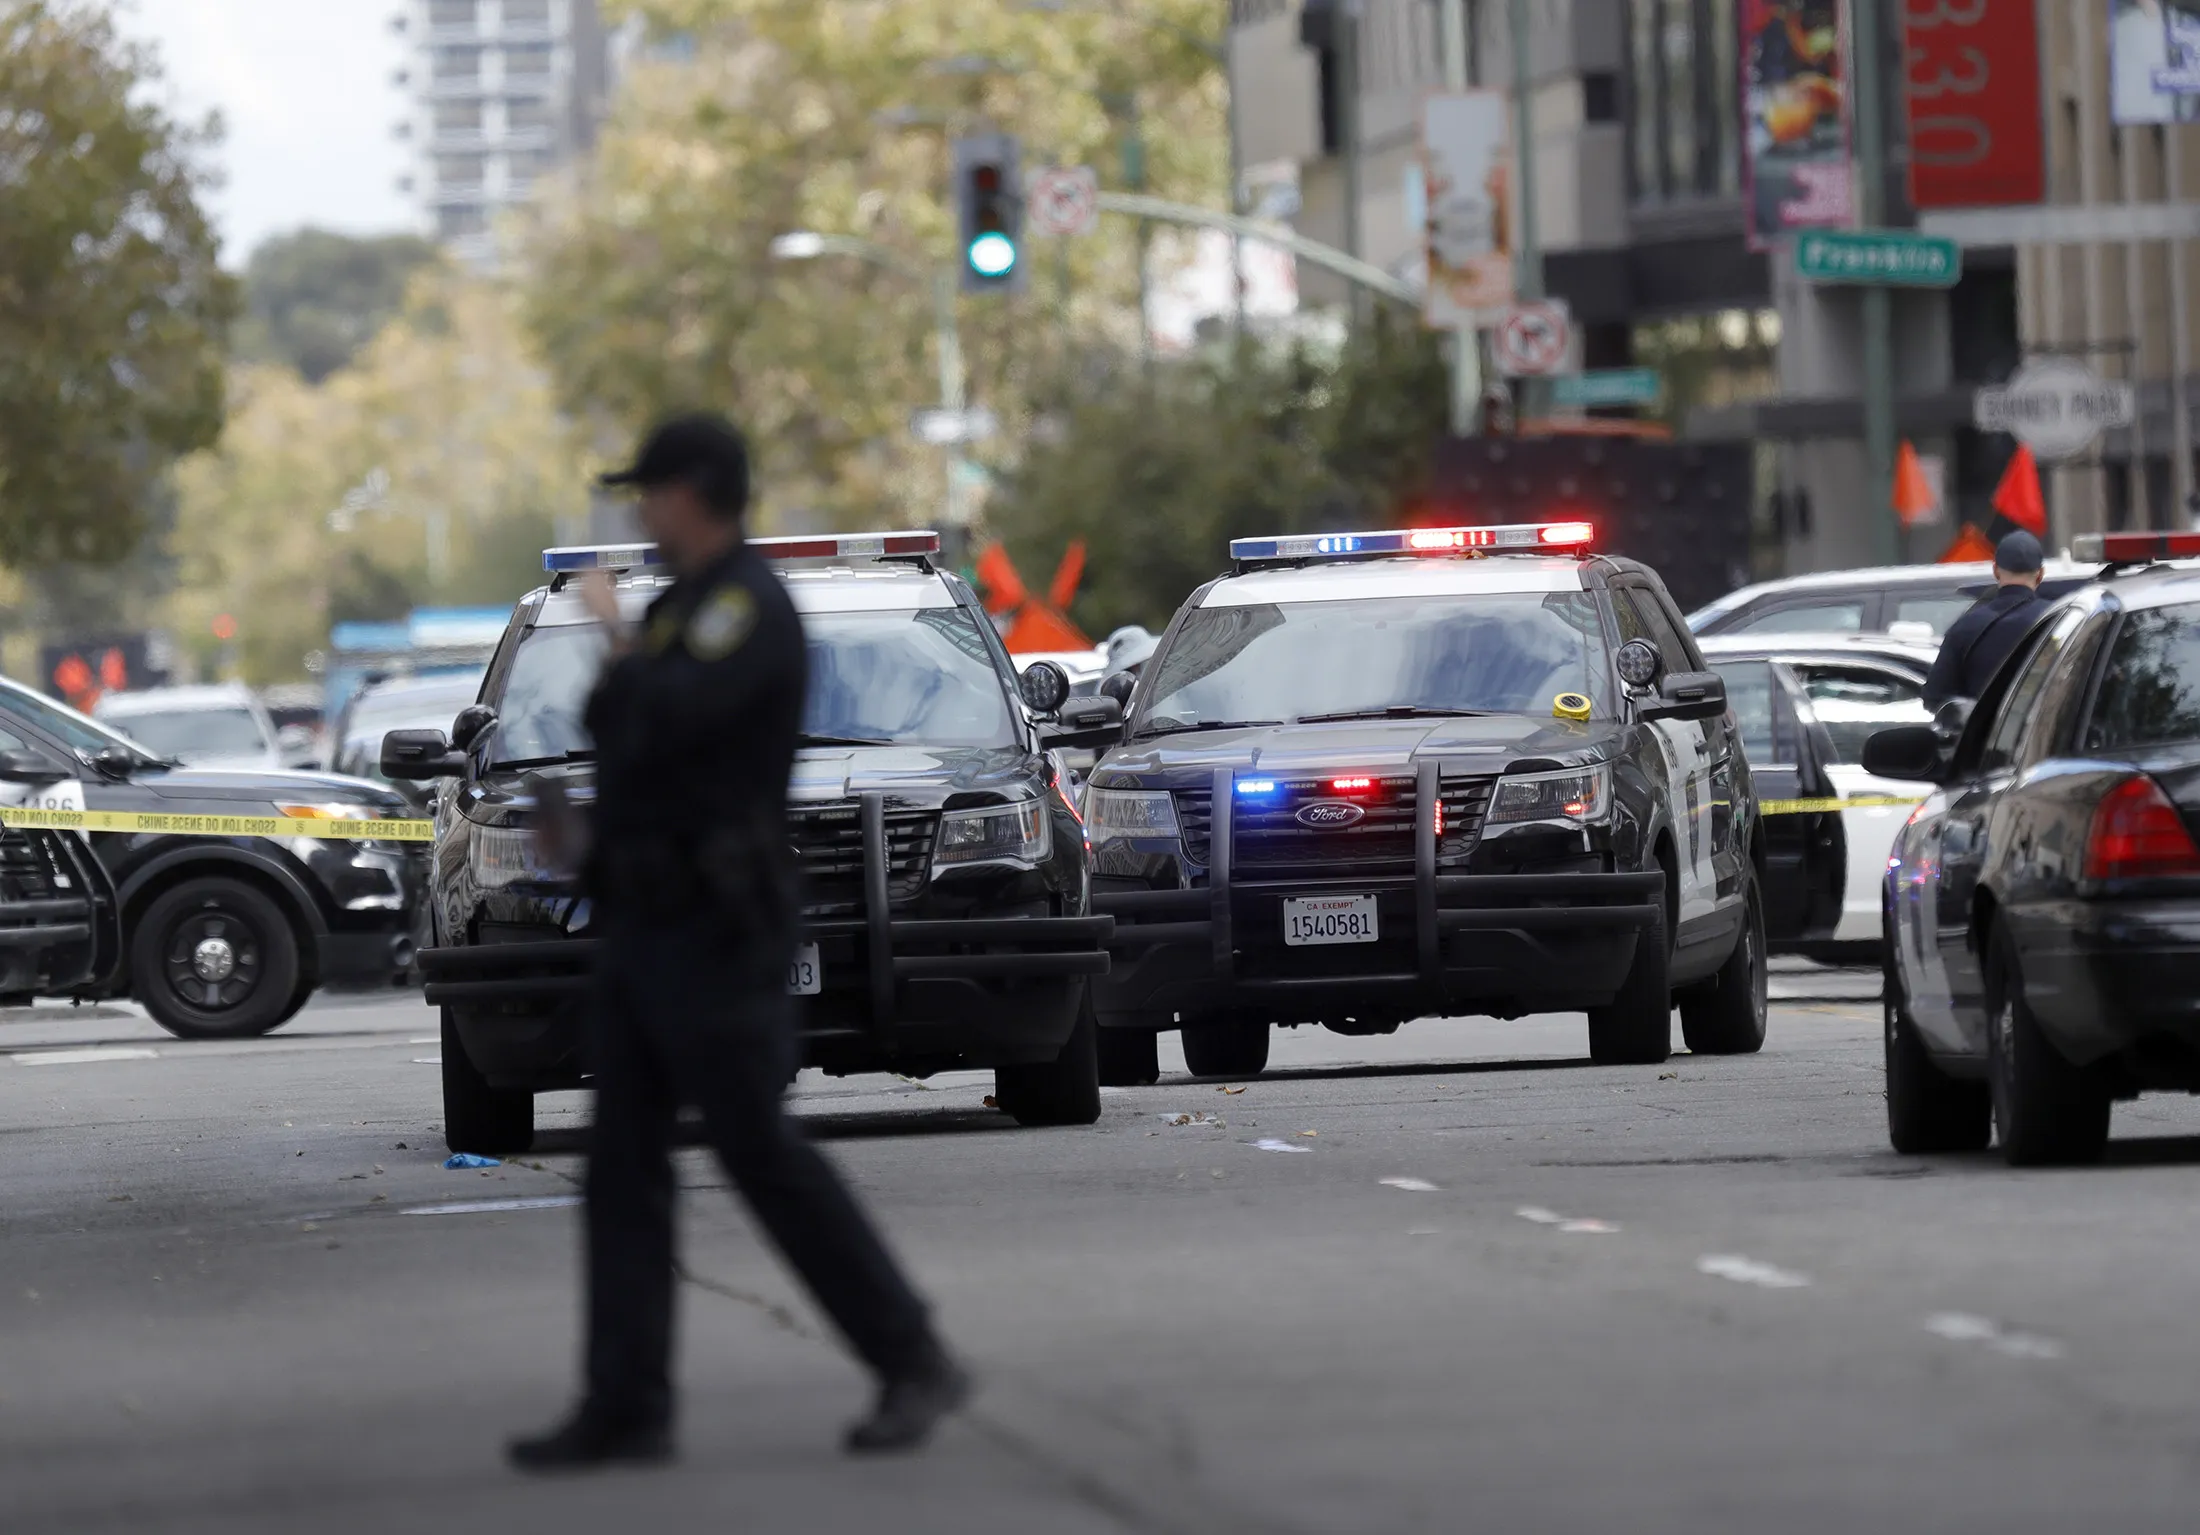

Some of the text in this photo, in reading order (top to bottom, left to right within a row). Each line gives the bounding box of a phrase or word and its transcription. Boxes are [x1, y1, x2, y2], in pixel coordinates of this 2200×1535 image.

[1805, 238, 1947, 273] Franklin
[1310, 806, 1347, 821] Ford
[1306, 901, 1354, 911] CA EXEMPT
[1292, 912, 1371, 938] 1540581
